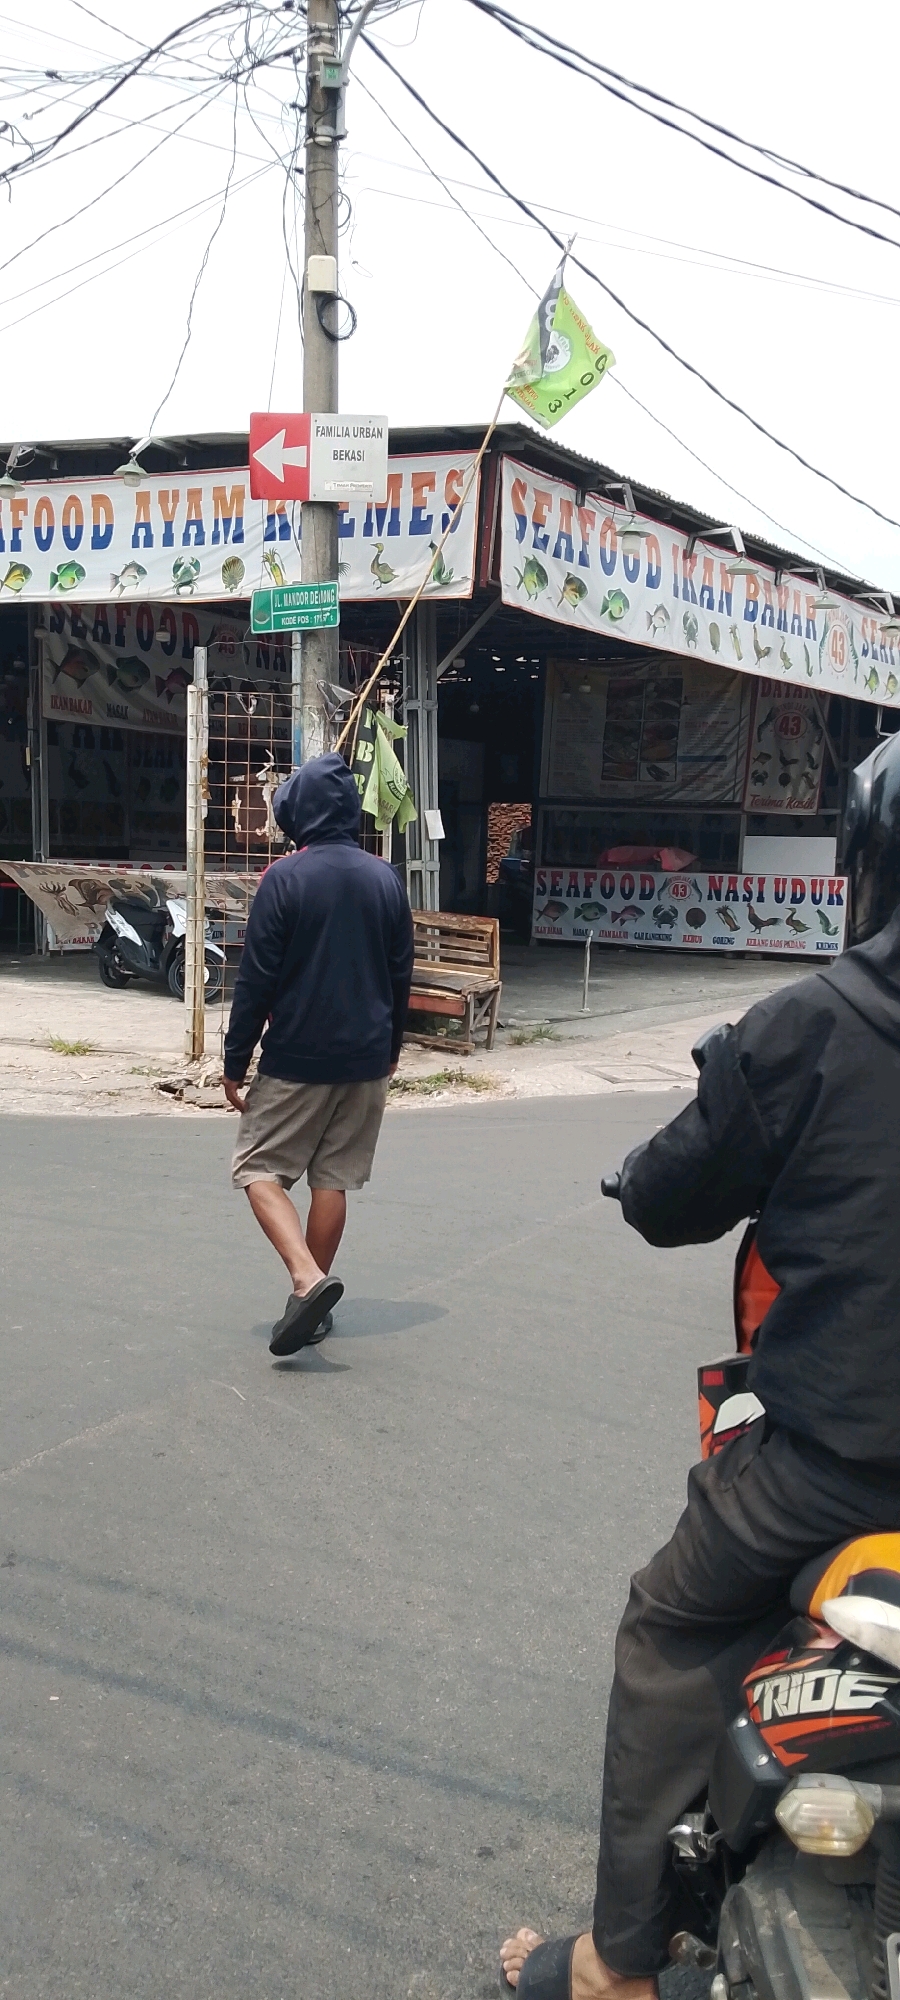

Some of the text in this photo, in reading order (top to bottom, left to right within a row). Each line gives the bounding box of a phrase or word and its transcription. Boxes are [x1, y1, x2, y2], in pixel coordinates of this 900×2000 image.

[315, 426, 383, 439] FAMILIA URBAN
[332, 449, 365, 461] BEKASI
[0, 493, 115, 553] FOOD
[131, 484, 246, 549] AYAM
[274, 594, 283, 608] JL.
[283, 590, 309, 607] MANDOR
[671, 543, 735, 617] IKAN
[743, 573, 817, 641] BAKAR
[281, 616, 297, 625] KODE
[297, 615, 309, 625] POS
[831, 630, 845, 666] 43
[106, 702, 129, 720] MASAK
[778, 715, 802, 736] 43
[750, 794, 815, 810] Terima Kasih
[536, 870, 845, 906] SEAFOOD NASI UDUK
[672, 884, 688, 898] 43
[712, 936, 735, 945] GORENG
[746, 938, 769, 947] KERANG
